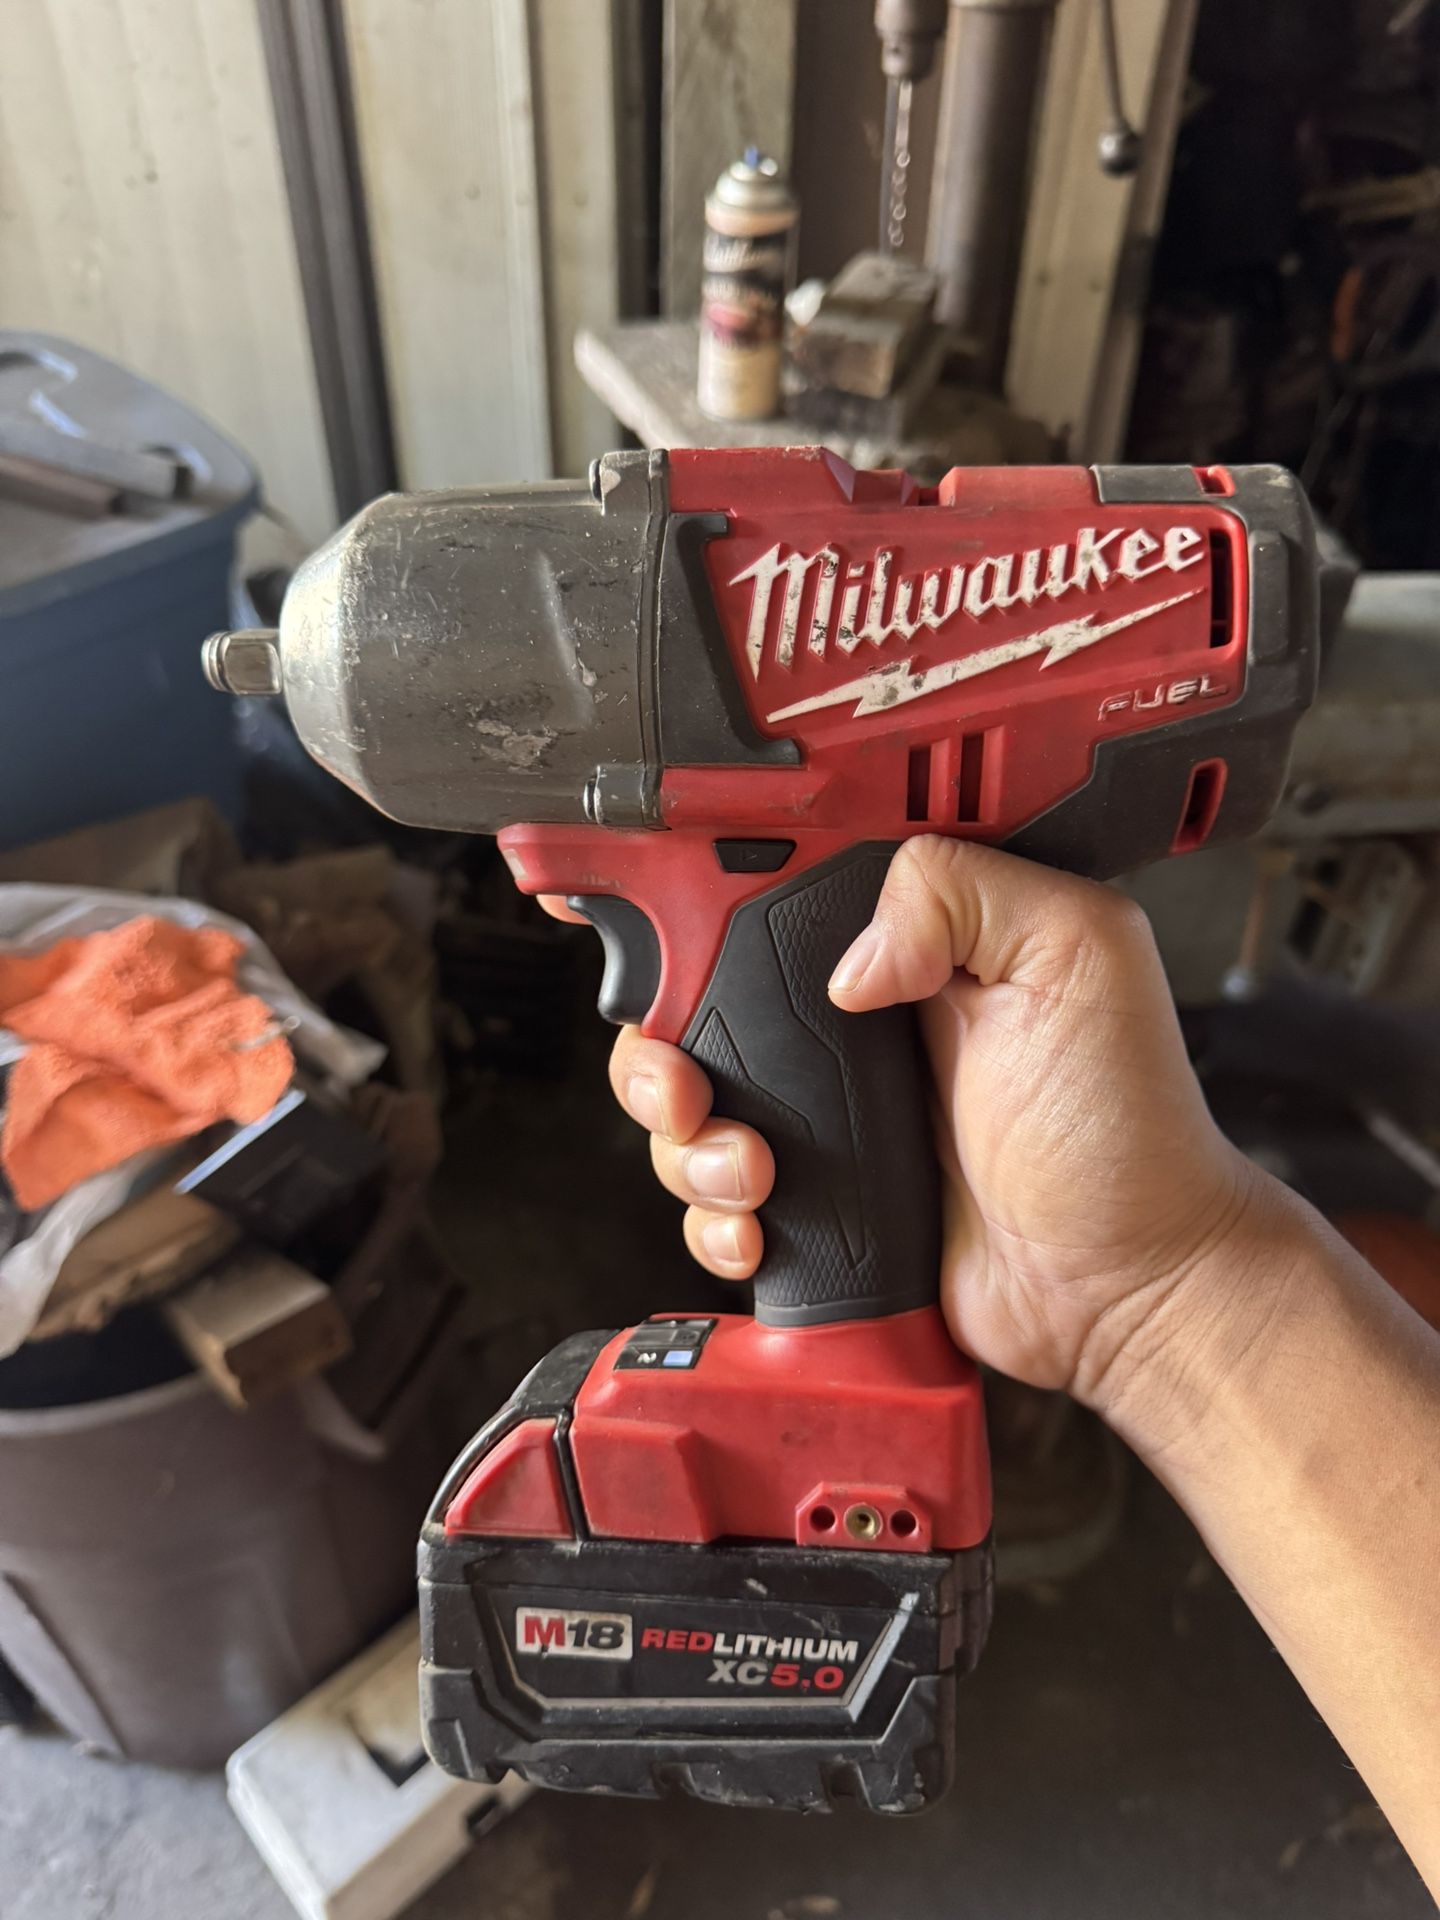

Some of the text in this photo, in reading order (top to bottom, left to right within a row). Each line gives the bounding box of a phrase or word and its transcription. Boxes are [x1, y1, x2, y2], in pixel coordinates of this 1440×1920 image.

[728, 526, 1205, 683] Milwaukee
[1097, 672, 1229, 721] FUEL
[523, 1614, 625, 1652] M18
[640, 1628, 859, 1662] REDLITHIUM
